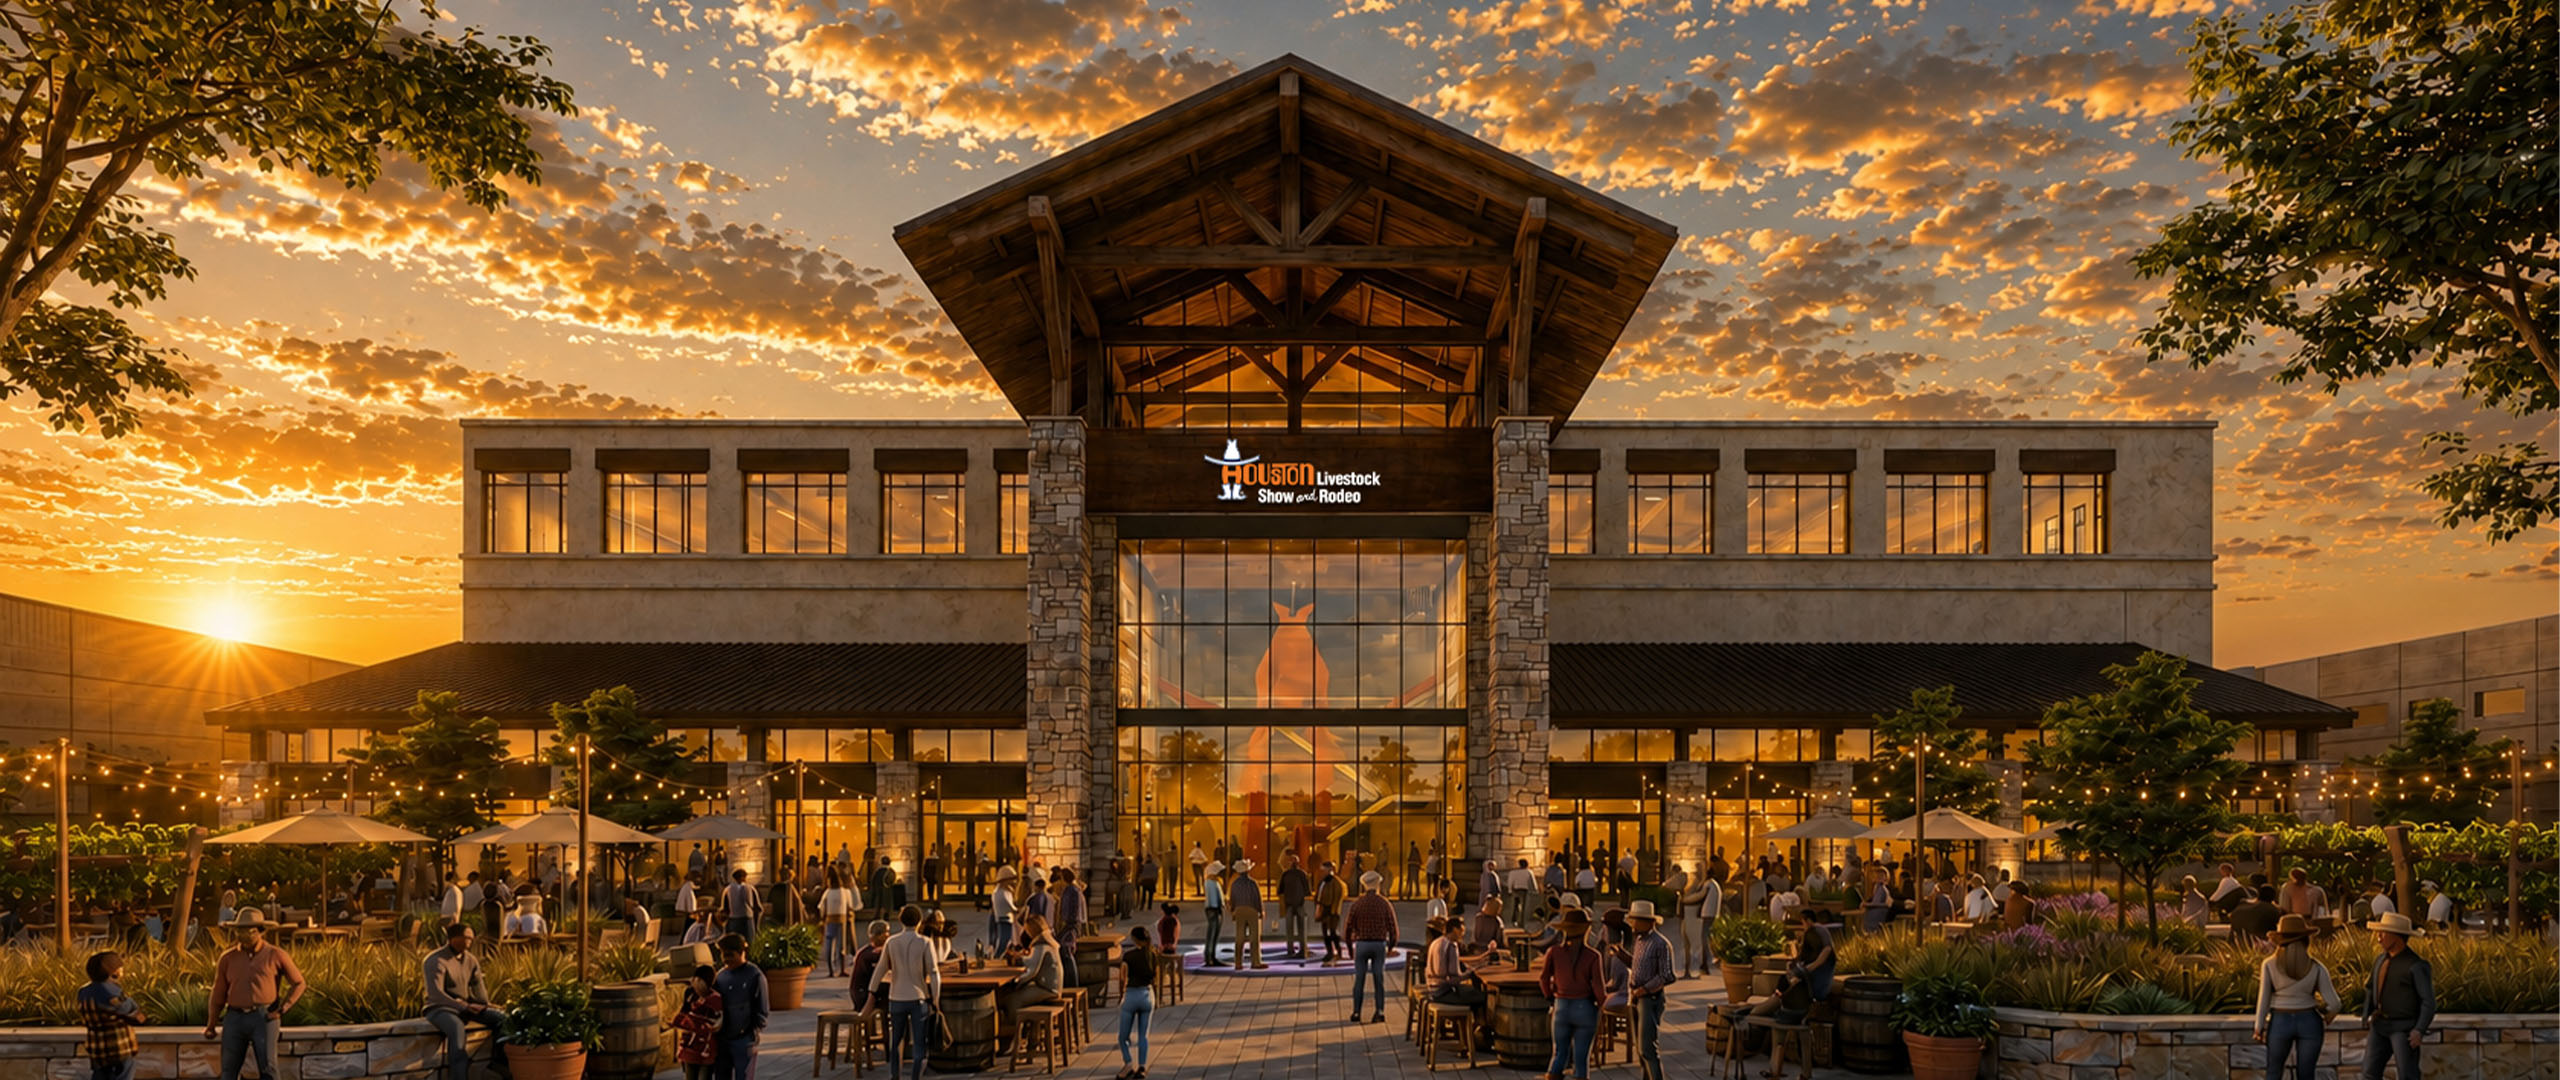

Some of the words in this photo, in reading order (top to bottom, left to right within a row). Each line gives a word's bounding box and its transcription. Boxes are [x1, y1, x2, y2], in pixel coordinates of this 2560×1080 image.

[1221, 463, 1315, 486] HOUSTON
[1316, 471, 1381, 486] Livestock
[1257, 488, 1294, 503] Show
[1296, 489, 1318, 503] and
[1318, 488, 1362, 503] Rodeo
